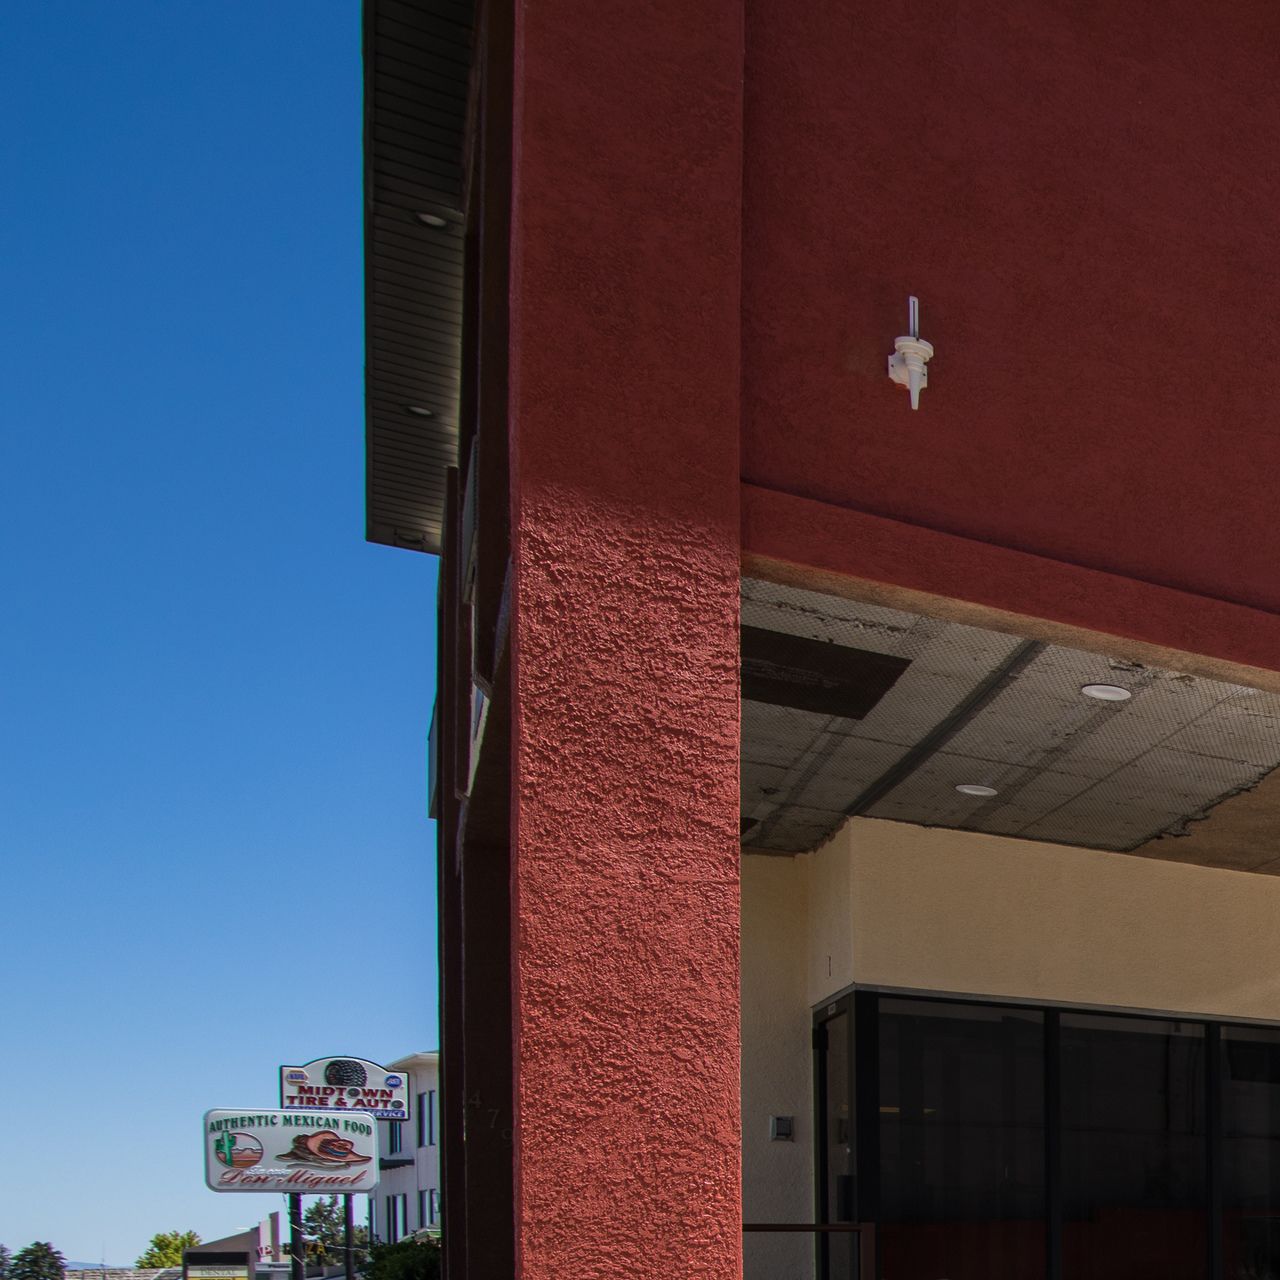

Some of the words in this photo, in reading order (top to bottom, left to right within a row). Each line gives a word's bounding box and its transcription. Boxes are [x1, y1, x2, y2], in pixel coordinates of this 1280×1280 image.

[297, 1086, 394, 1099] MIDTOWN
[286, 1095, 329, 1106] TIRE
[335, 1098, 348, 1107] &
[351, 1099, 404, 1109] AUTO
[209, 1115, 278, 1133] AUTHENTIC
[282, 1115, 340, 1130] MEXICAN
[344, 1119, 373, 1136] FOOD
[219, 1168, 271, 1185] Don
[277, 1168, 367, 1187] Miguel
